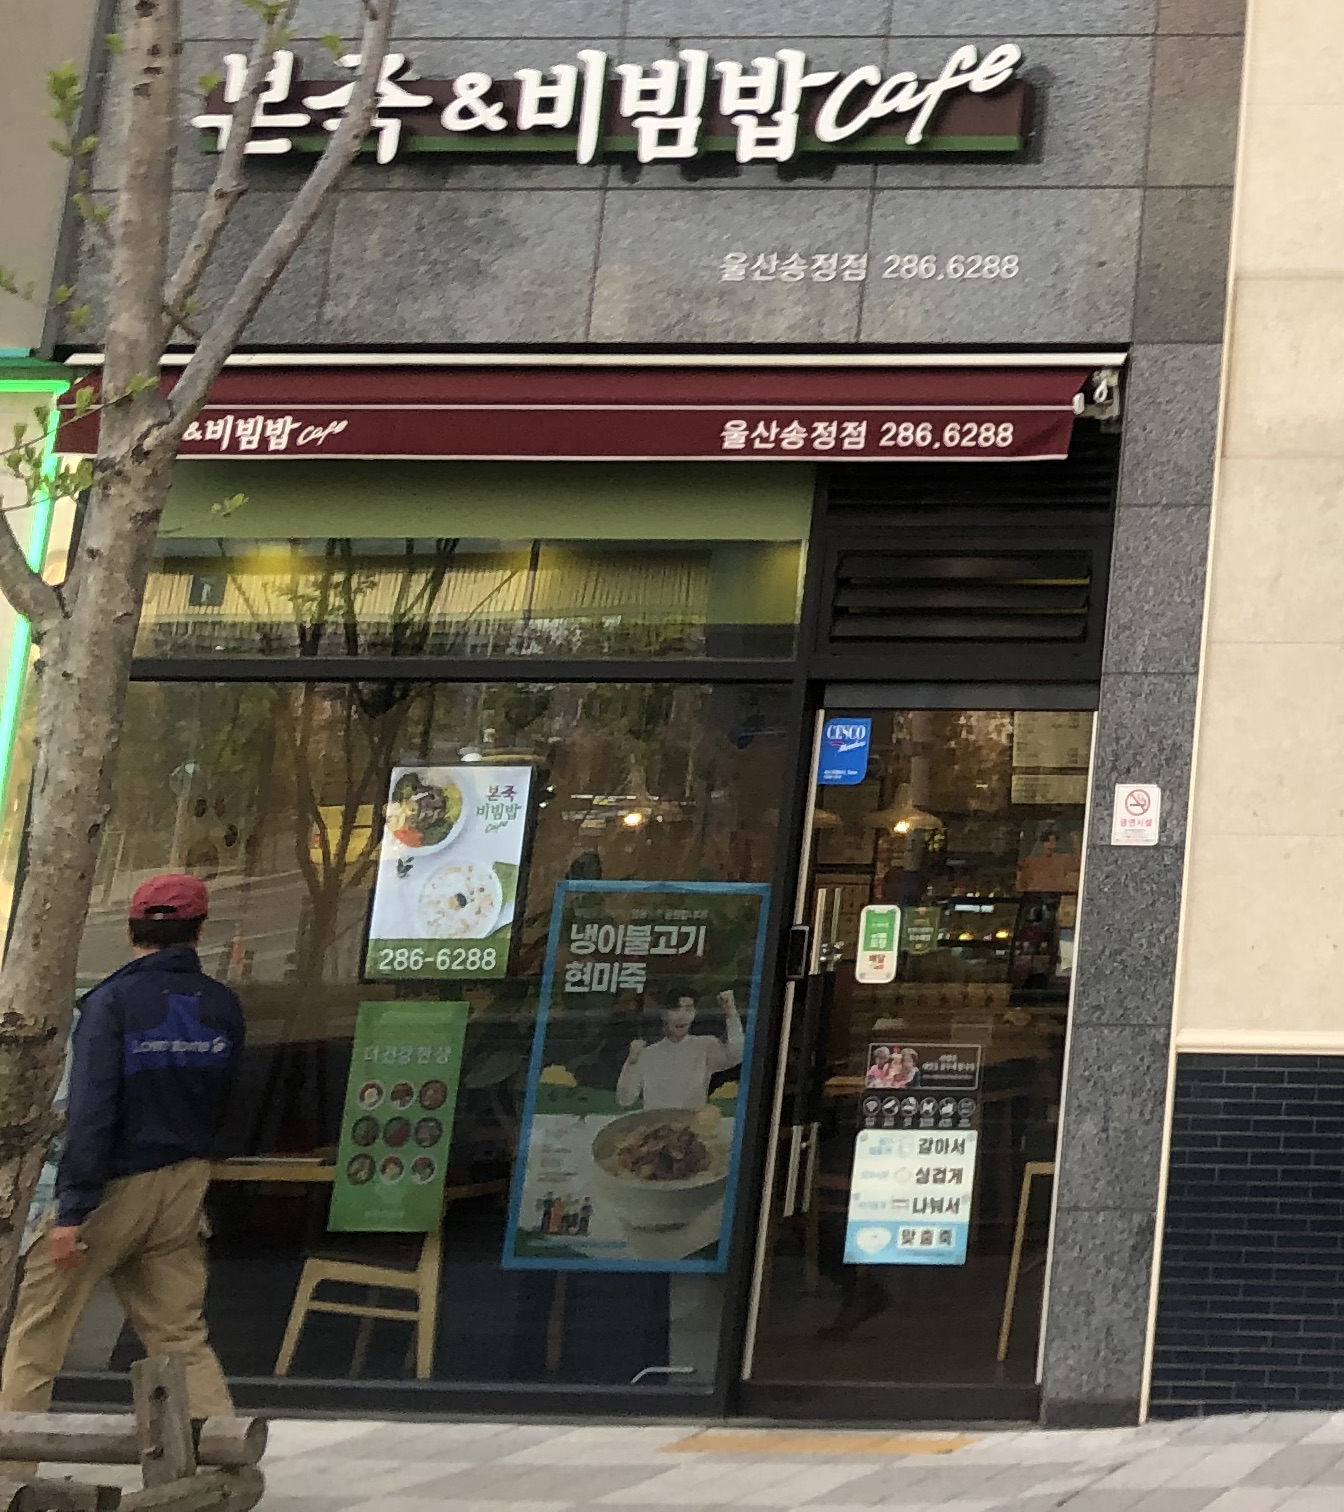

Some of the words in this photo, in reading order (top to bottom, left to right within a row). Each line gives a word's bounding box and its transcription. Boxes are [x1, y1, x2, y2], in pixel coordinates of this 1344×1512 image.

[718, 252, 869, 283] 울산송정점
[719, 420, 867, 451] 울산송정점
[826, 725, 866, 740] CESCO
[487, 785, 517, 802] 본죽
[476, 802, 523, 821] 비빔밥
[569, 924, 707, 957] 냉이불고기
[378, 947, 497, 971] 286-6288
[565, 960, 648, 995] 현미죽
[915, 1166, 964, 1185] 싱겁게
